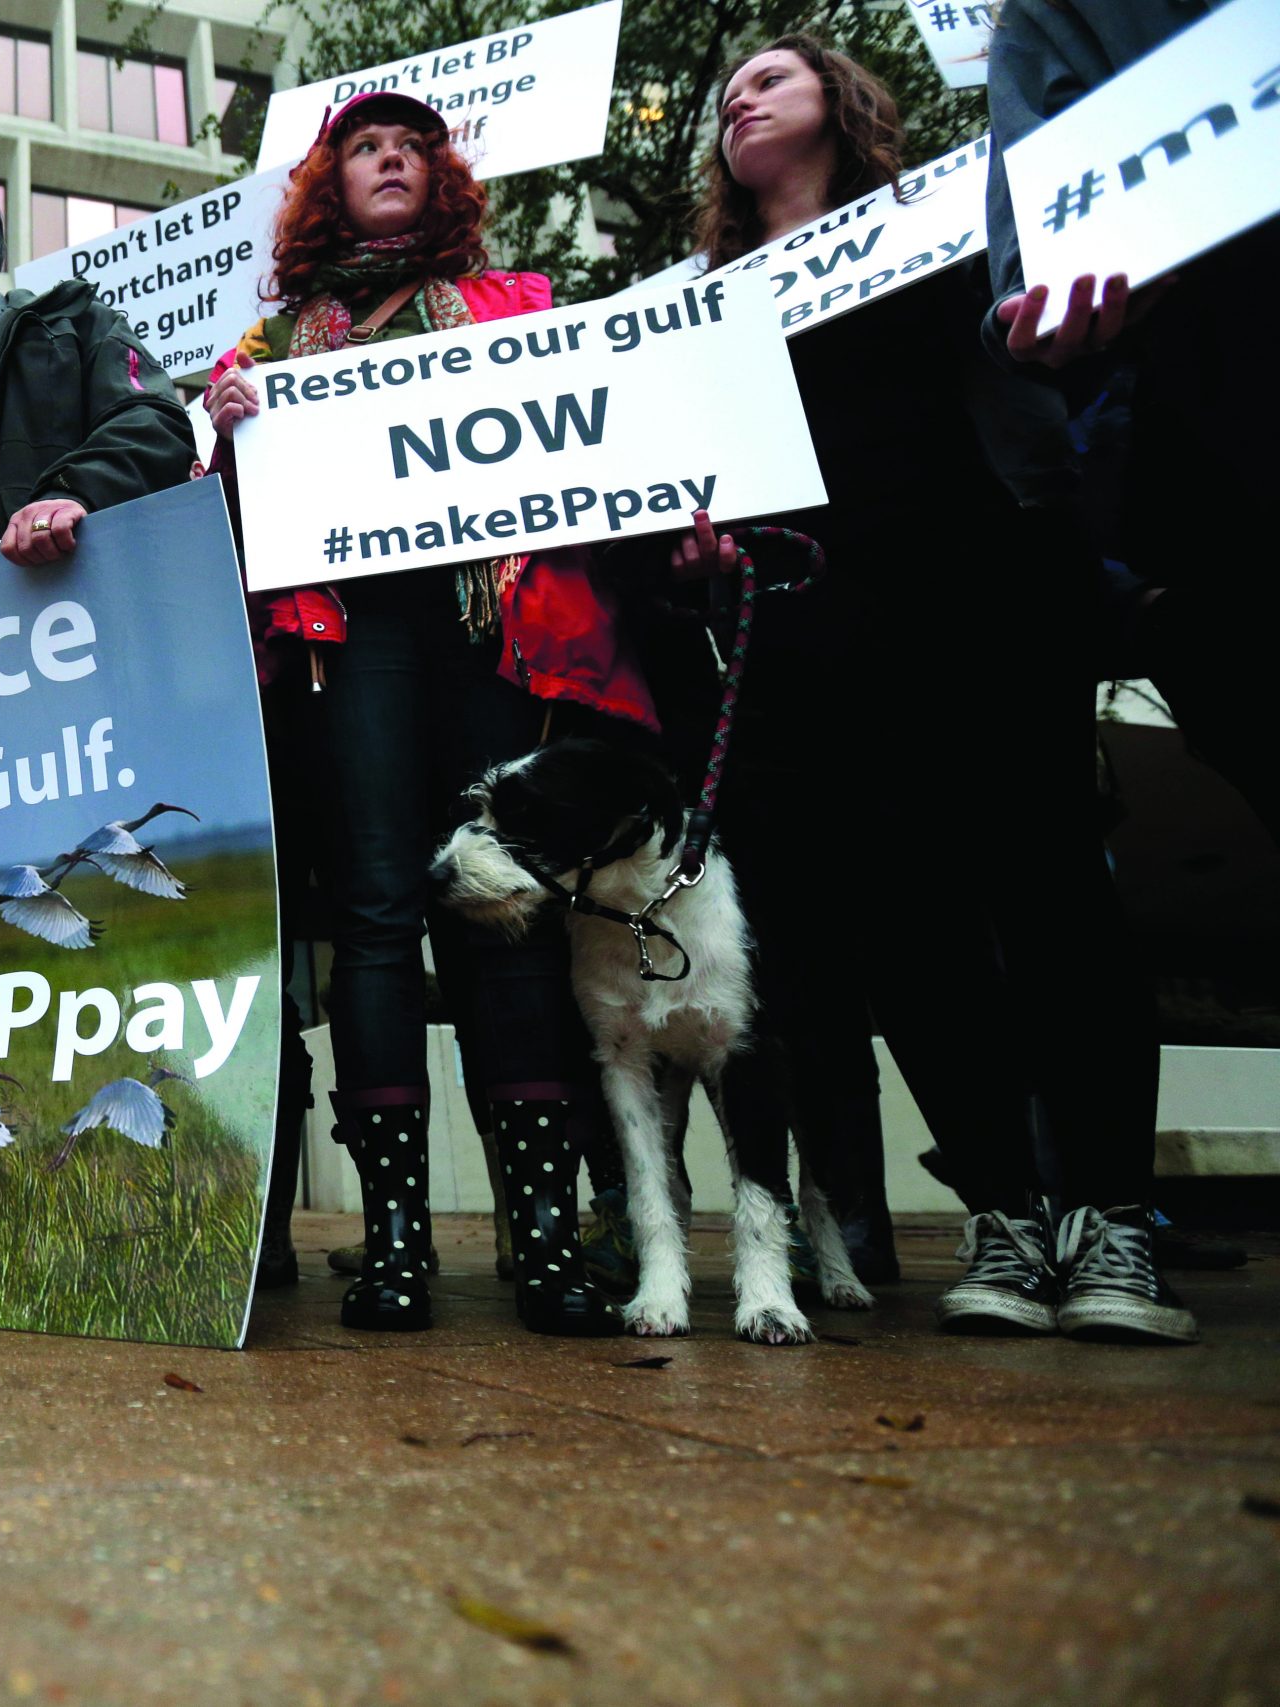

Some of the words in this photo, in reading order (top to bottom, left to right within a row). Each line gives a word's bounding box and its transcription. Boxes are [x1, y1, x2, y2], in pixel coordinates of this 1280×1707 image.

[333, 65, 423, 104] Don't
[431, 50, 476, 79] let
[486, 32, 533, 64] BP
[72, 230, 147, 278] Don't
[155, 212, 193, 246] let
[202, 191, 241, 229] BP
[784, 198, 876, 252] our
[899, 139, 988, 200] gul
[101, 240, 253, 307] ortchange
[157, 288, 218, 340] gulf
[781, 229, 975, 328] BPpay
[159, 344, 215, 369] BPpay
[264, 345, 473, 410] Restore
[488, 320, 588, 366] our
[604, 280, 725, 352] gulf
[388, 386, 609, 479] NOW
[323, 474, 717, 565] #makeBPpay
